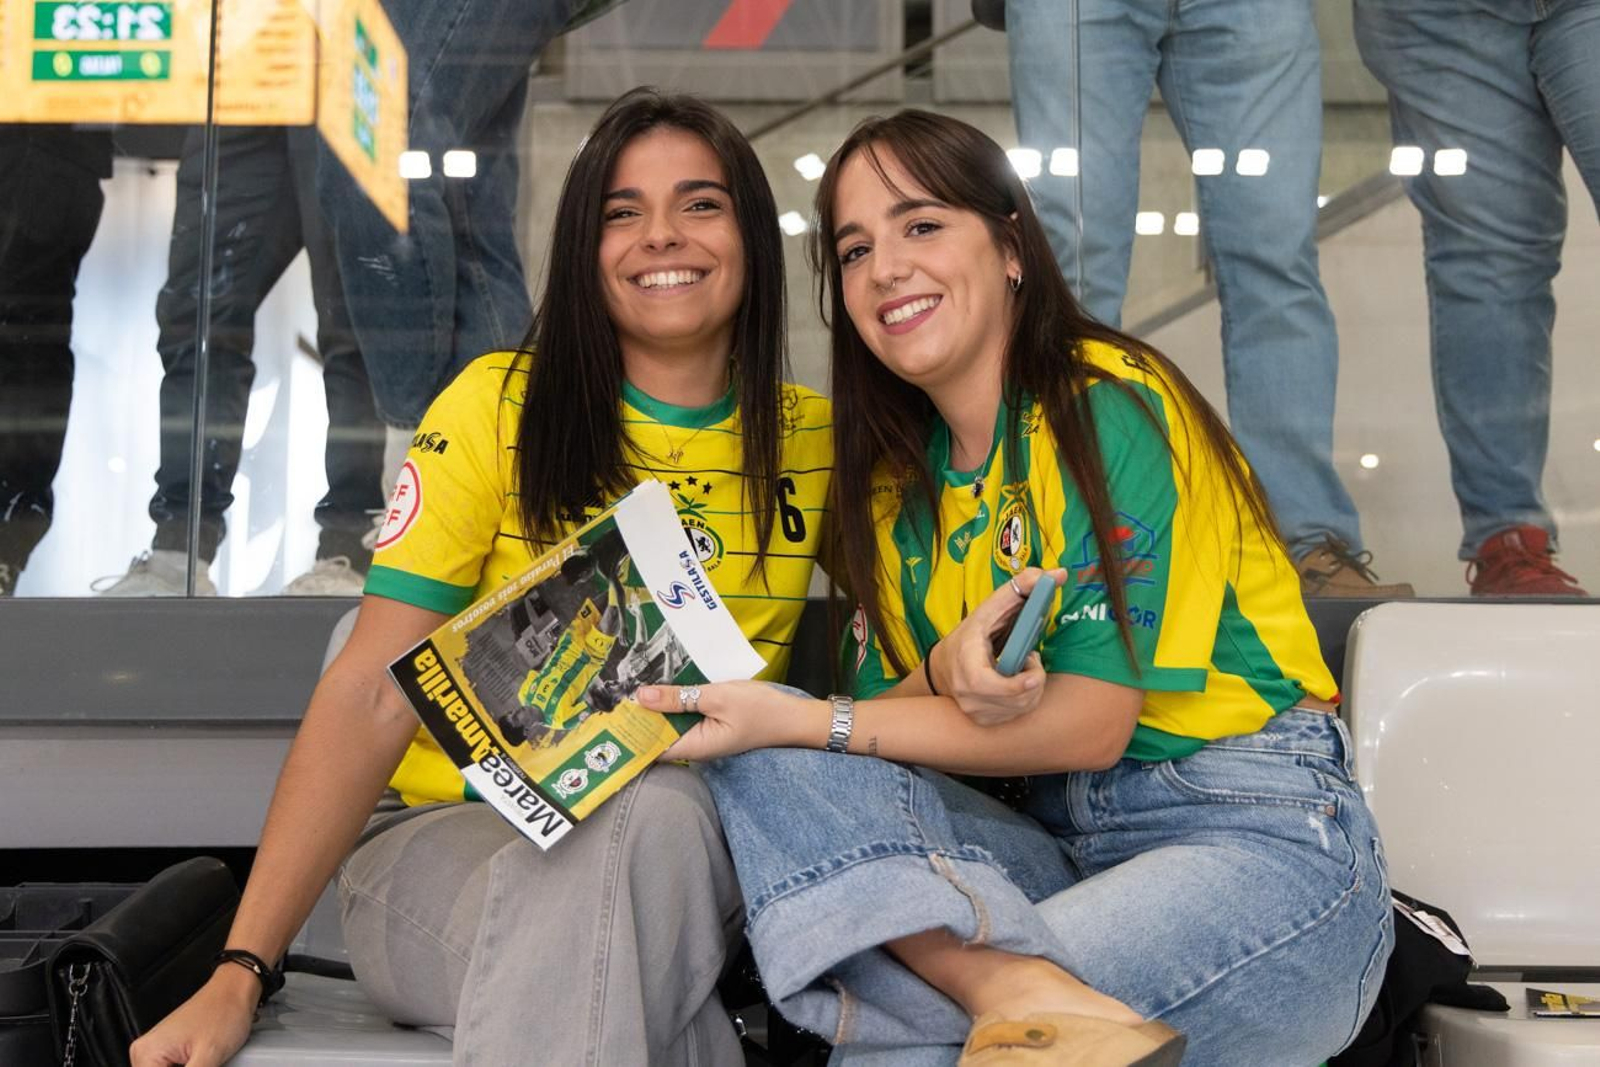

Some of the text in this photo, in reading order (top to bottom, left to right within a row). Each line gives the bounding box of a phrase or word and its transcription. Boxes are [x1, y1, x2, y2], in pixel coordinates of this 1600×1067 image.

[681, 518, 705, 529] AEN
[776, 476, 807, 543] 6
[562, 544, 575, 562] El
[678, 550, 718, 611] GESTILASA
[452, 597, 496, 633] vosotros
